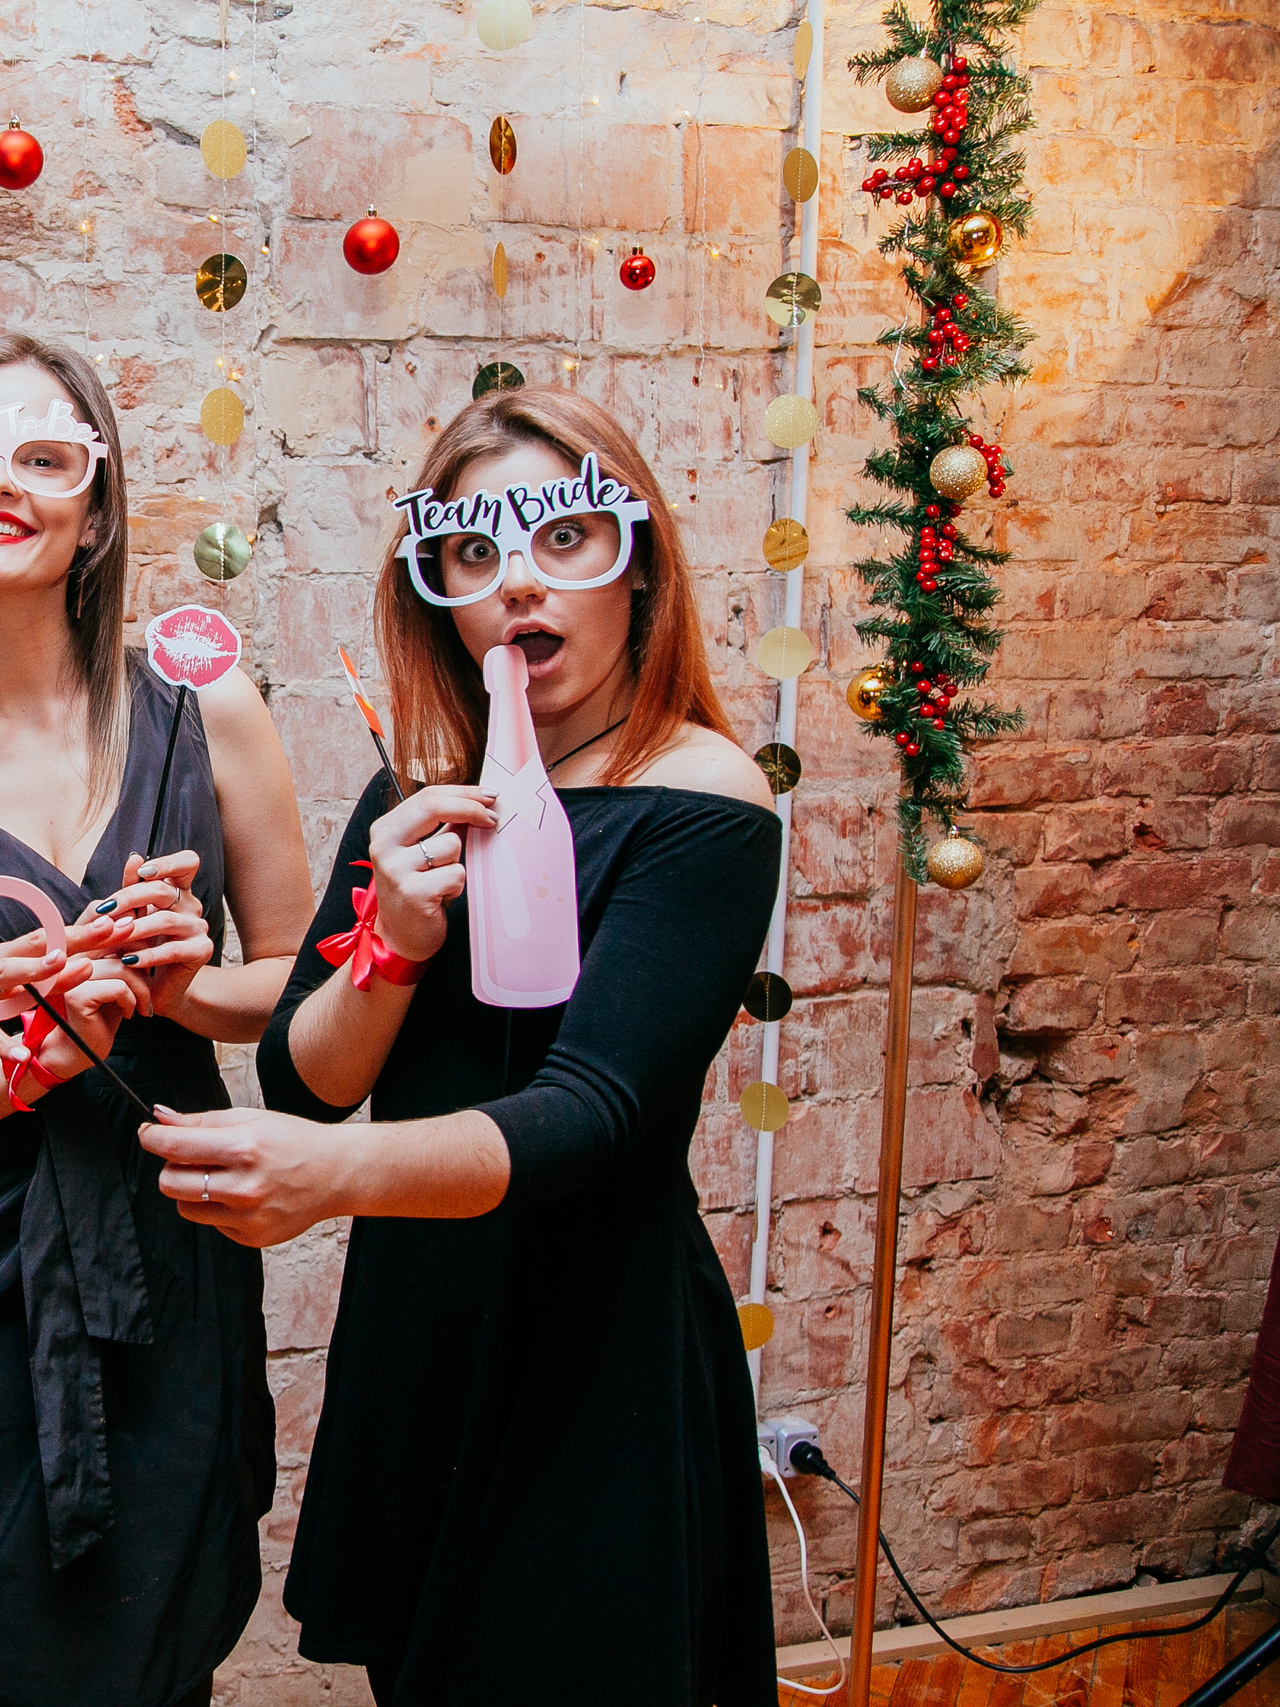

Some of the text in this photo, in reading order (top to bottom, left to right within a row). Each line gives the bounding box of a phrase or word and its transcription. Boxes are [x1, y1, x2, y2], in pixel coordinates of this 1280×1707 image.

[46, 399, 99, 441] Be
[394, 457, 626, 537] Team Bride
